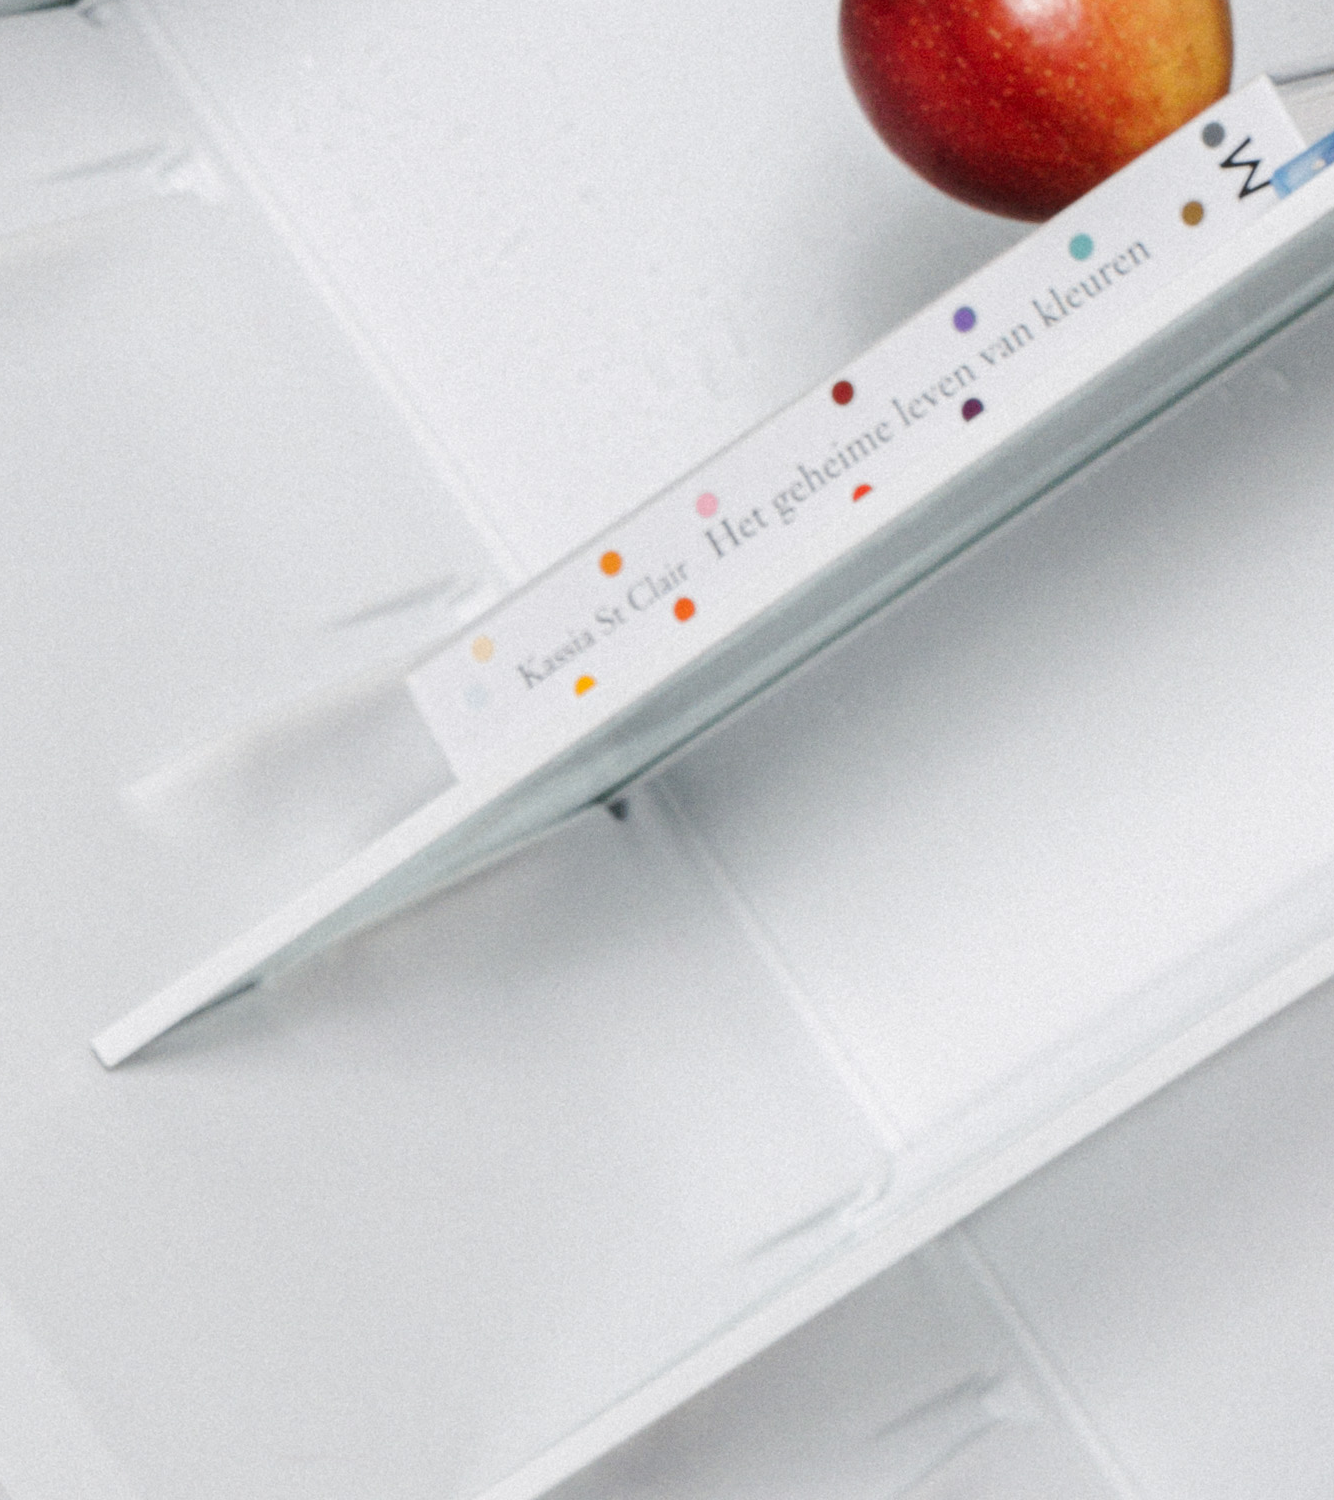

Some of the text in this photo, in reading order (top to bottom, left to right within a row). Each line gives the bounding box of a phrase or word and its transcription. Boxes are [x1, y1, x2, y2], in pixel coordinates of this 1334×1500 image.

[703, 237, 1153, 560] Het geheime leven van kleuren
[516, 561, 690, 690] Kassia St Clair
